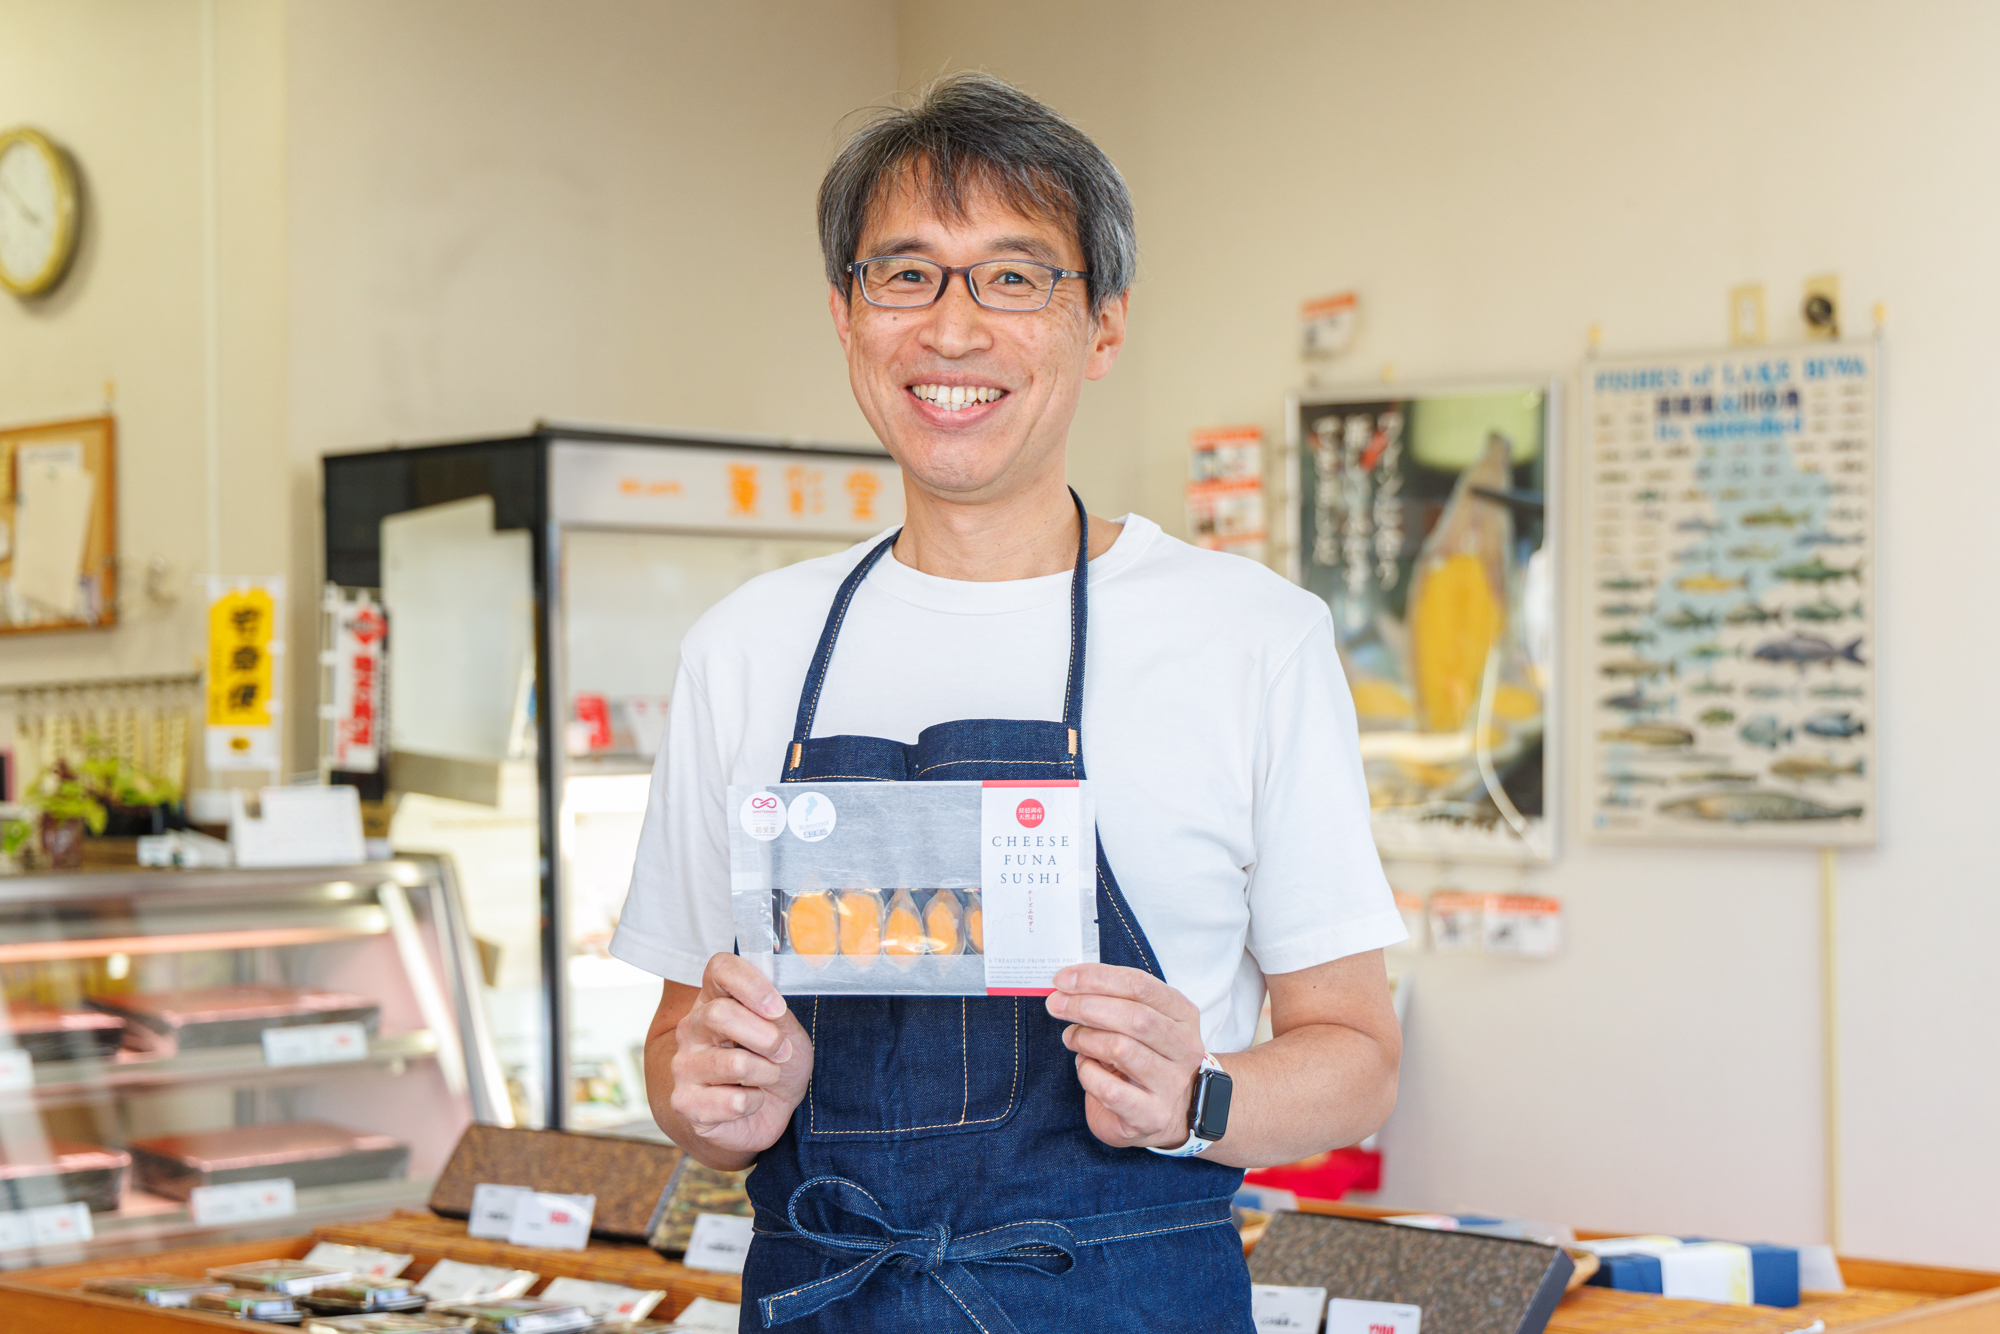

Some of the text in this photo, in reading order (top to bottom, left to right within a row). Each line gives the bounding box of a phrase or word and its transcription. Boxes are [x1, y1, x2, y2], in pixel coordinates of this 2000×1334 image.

[1723, 359, 1793, 386] LAKE
[1805, 356, 1867, 381] BIWA
[992, 835, 1069, 847] CHEESE
[1004, 854, 1057, 865] FUNA
[1000, 873, 1060, 884] SUSHI
